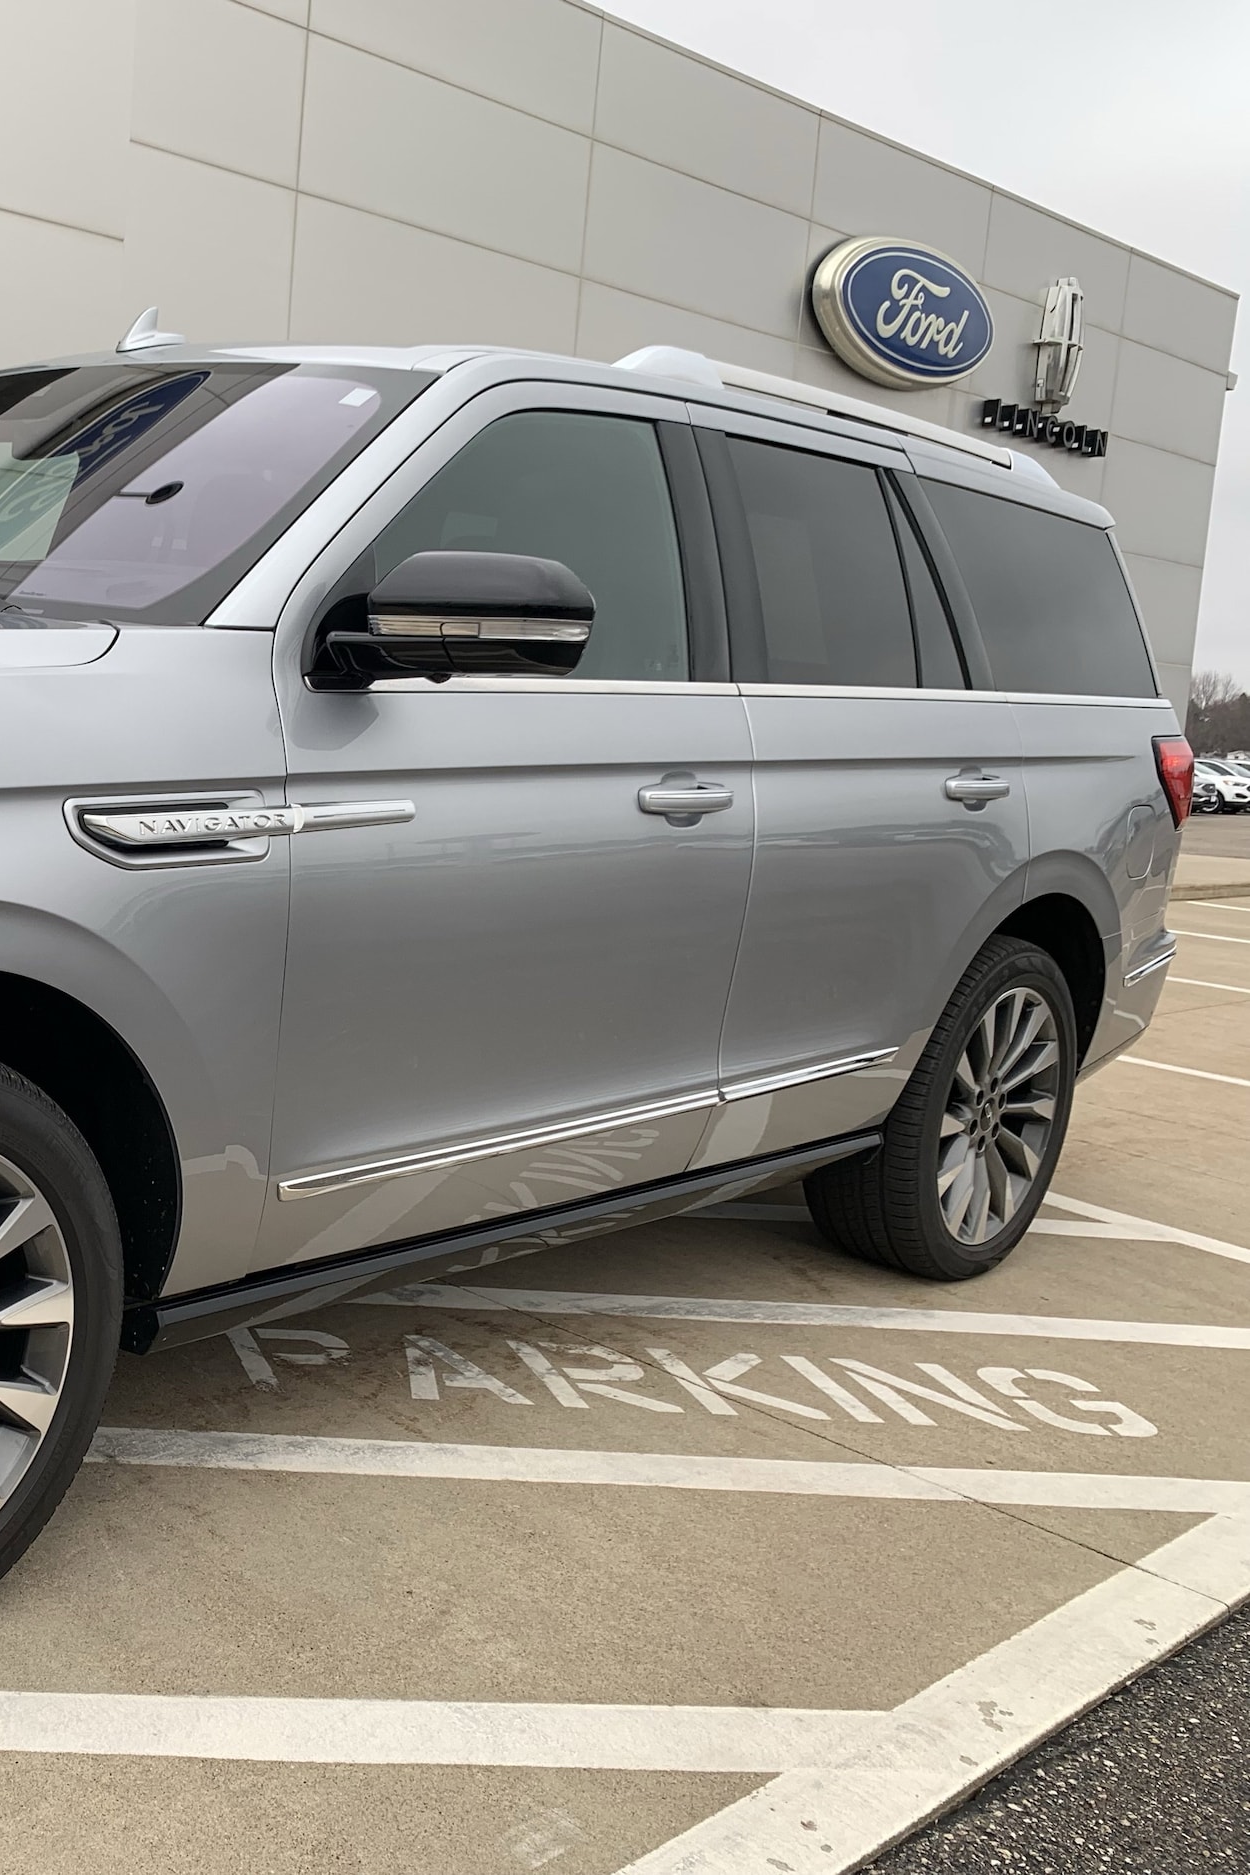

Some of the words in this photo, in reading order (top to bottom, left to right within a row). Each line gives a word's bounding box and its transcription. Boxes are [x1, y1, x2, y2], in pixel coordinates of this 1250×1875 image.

[876, 268, 970, 359] Ford
[982, 398, 1108, 457] LINCOLN
[138, 812, 287, 836] NAVIGATOR
[225, 1327, 1159, 1439] PARKING
